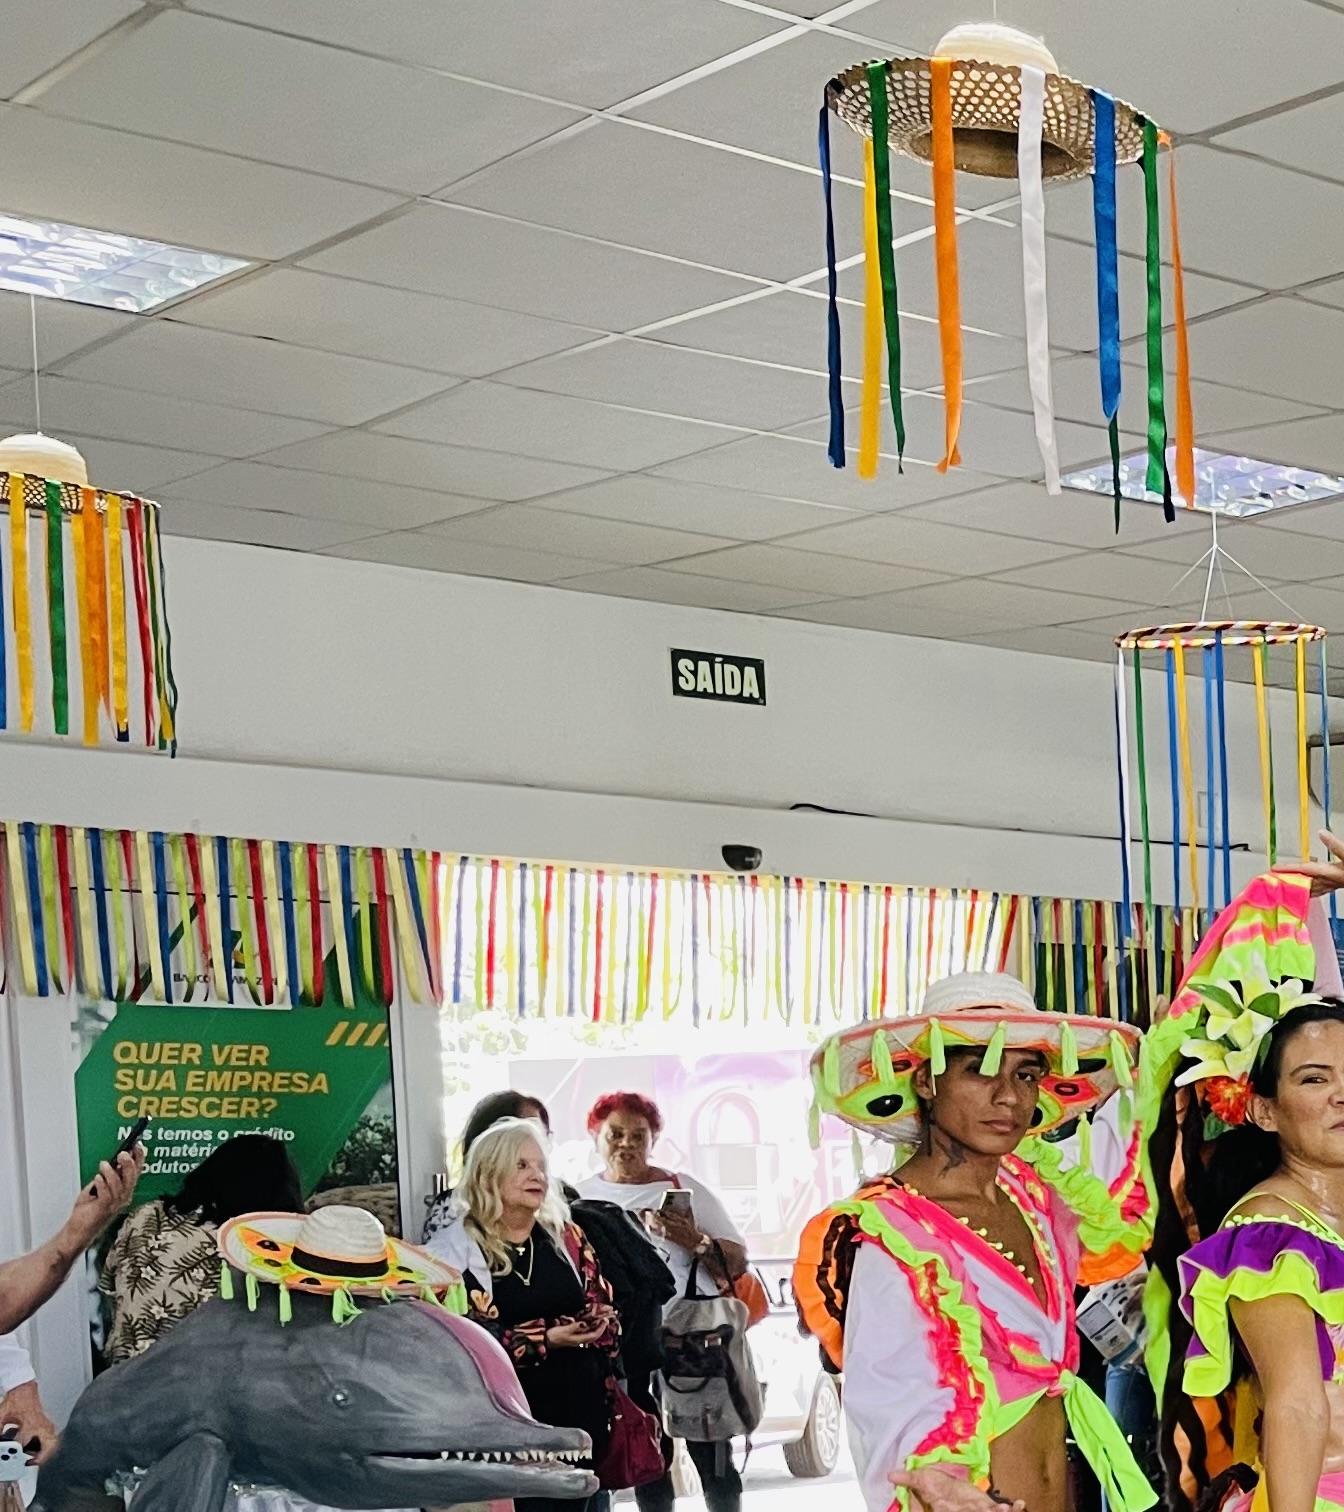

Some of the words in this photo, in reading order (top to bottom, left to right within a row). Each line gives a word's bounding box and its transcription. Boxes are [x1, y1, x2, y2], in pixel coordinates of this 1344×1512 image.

[677, 656, 760, 699] SAÍDA
[113, 1041, 203, 1065] QUER
[212, 1044, 270, 1066] VER
[114, 1068, 177, 1092] SUA
[185, 1070, 329, 1094] EMPRESA
[117, 1095, 278, 1119] CRESCER?
[117, 1126, 153, 1141] Ns
[157, 1127, 213, 1141] temos
[217, 1129, 229, 1141] o
[153, 1142, 219, 1158] matéri
